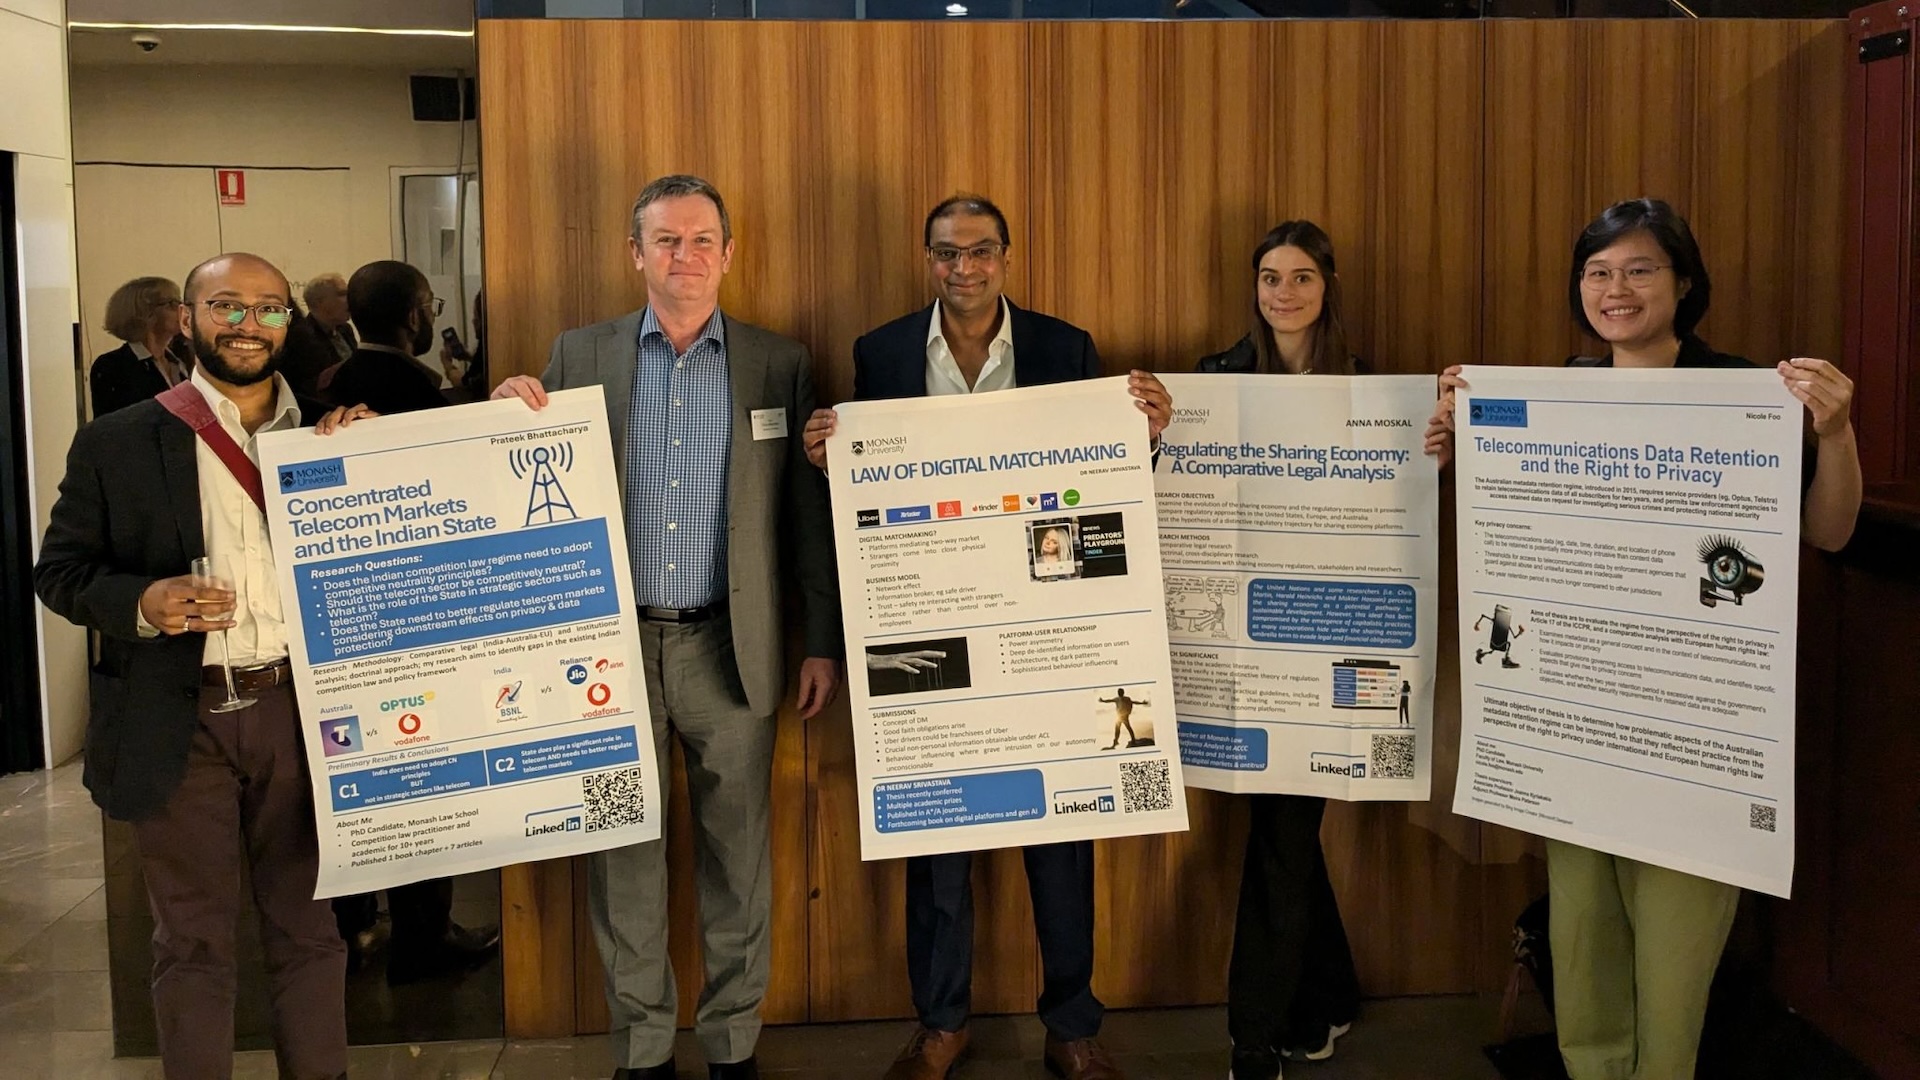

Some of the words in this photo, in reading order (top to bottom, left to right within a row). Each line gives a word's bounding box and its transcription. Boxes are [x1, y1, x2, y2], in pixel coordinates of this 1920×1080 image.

[1172, 408, 1209, 417] MONASH
[1484, 405, 1526, 415] MONASH
[1746, 412, 1767, 420] Nicole
[1172, 416, 1207, 425] University
[1346, 419, 1372, 427] ANNA
[1374, 419, 1413, 427] MOSKAL
[490, 434, 525, 445] Prateek
[526, 426, 589, 440] Bhattacharya
[866, 436, 907, 447] MONASH
[866, 445, 905, 456] University
[1159, 441, 1238, 461] Regulating
[1239, 442, 1266, 458] the
[1268, 443, 1327, 464] Sharing
[1331, 446, 1410, 465] Economy:
[1474, 436, 1639, 460] Telecommunications
[1645, 444, 1684, 463] Data
[1690, 447, 1779, 468] Retention
[296, 464, 341, 478] MONASH
[851, 465, 891, 484] LAW
[894, 463, 918, 480] OF
[921, 456, 987, 477] DIGITAL
[989, 443, 1126, 471] MATCHMAKING
[1171, 460, 1184, 474] A
[1186, 460, 1284, 478] Comparative
[1287, 462, 1327, 481] Legal
[1330, 464, 1395, 483] Analysis
[1521, 458, 1549, 473] and
[1554, 459, 1579, 475] the
[1585, 460, 1629, 481] Right
[1634, 463, 1651, 479] to
[1657, 464, 1723, 488] Privacy
[287, 479, 432, 516] Concentrated
[978, 503, 998, 511] tinder
[288, 512, 381, 537] Telecom
[383, 499, 468, 524] Markets
[857, 513, 880, 522] Uber
[295, 536, 335, 559] and
[336, 534, 373, 552] the
[375, 525, 440, 546] Indian
[442, 516, 496, 535] State
[311, 563, 362, 579] Research
[323, 580, 351, 591] Does
[352, 577, 370, 586] the
[371, 571, 404, 583] Indian
[405, 562, 467, 577] competition
[468, 559, 486, 568] law
[488, 553, 522, 565] regime
[524, 547, 549, 559] need
[550, 547, 561, 555] to
[563, 541, 593, 553] adopt
[325, 583, 386, 600] competitive
[388, 574, 436, 589] neutrality
[326, 595, 363, 609] Should
[365, 593, 382, 602] the
[383, 587, 426, 600] telecom
[427, 581, 460, 593] sector
[461, 579, 475, 587] be
[476, 568, 543, 585] competitively
[327, 606, 357, 618] What
[358, 604, 367, 613] is
[368, 602, 386, 611] the
[387, 598, 407, 608] role
[409, 595, 419, 605] of
[421, 594, 438, 603] the
[439, 590, 466, 600] State
[468, 587, 478, 596] in
[479, 581, 523, 594] strategic
[524, 575, 562, 587] sectors
[563, 569, 588, 581] such
[589, 568, 602, 576] as
[331, 626, 359, 637] Does
[360, 622, 378, 631] the
[379, 618, 406, 628] State
[408, 612, 433, 624] need
[434, 612, 446, 620] to
[447, 607, 477, 618] better
[479, 600, 520, 613] regulate
[521, 593, 563, 606] telecom
[565, 586, 605, 599] markets
[333, 629, 394, 646] considering
[394, 619, 457, 635] downstream
[459, 613, 494, 625] effects
[495, 611, 509, 619] on
[510, 605, 546, 619] privacy
[548, 602, 556, 611] &
[557, 599, 580, 609] data
[560, 655, 593, 666] Reliance
[493, 666, 512, 676] India
[569, 669, 586, 680] Jio
[541, 686, 552, 694] v/s
[320, 704, 353, 714] Australia
[380, 695, 425, 712] OPTUS
[500, 707, 522, 717] BSNL
[582, 707, 621, 718] vodafone
[366, 728, 378, 737] v/s
[394, 734, 430, 746] vodafone
[495, 757, 515, 773] C2
[338, 783, 360, 799] C1
[350, 828, 366, 837] PhD
[408, 816, 437, 827] Monash
[438, 814, 453, 822] Law
[454, 808, 479, 819] School
